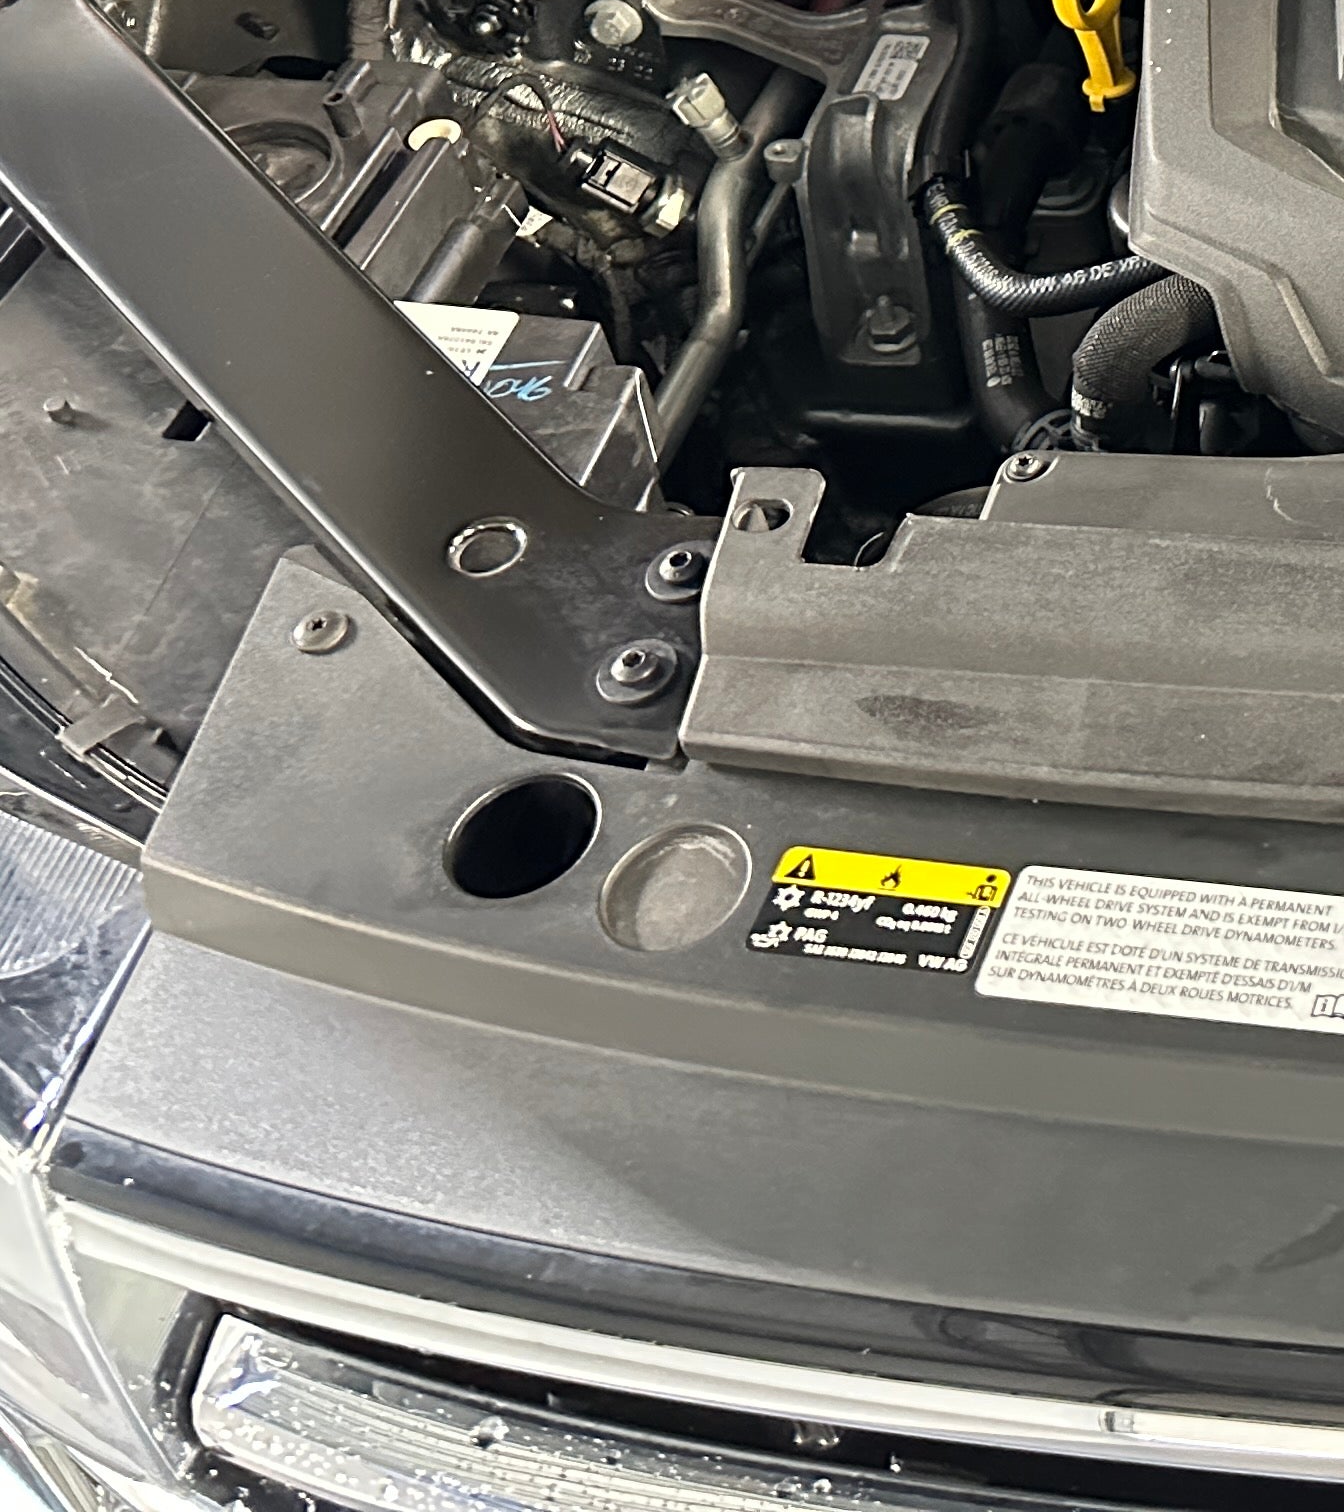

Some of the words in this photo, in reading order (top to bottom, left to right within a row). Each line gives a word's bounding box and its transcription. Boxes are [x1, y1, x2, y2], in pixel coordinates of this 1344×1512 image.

[810, 890, 875, 913] R-1234yf
[1018, 891, 1091, 909] ALL-WHEEL
[1094, 899, 1134, 914] DRIVE
[1137, 902, 1187, 918] SYSTEM
[1188, 908, 1220, 922] AND
[1222, 911, 1235, 924] IS
[1237, 913, 1290, 929] EXEMPT
[1292, 918, 1331, 933] FROM
[1026, 875, 1056, 888] THIS
[1058, 878, 1110, 894] VEHICLE
[1114, 884, 1127, 895] IS
[1129, 885, 1197, 903] EQUIPPED
[1199, 893, 1235, 907] WITH
[1237, 896, 1248, 907] A
[1250, 897, 1334, 917] PERMANENT
[793, 926, 829, 944] PAG
[1013, 906, 1067, 922] TESTING
[1070, 912, 1092, 925] ON
[1095, 914, 1128, 930] TWO
[1132, 919, 1178, 935] WHEEL
[1181, 923, 1225, 939] DRIVE
[1228, 928, 1337, 951] DYNAMOMETERS.
[918, 954, 947, 969] VW
[945, 958, 969, 973] AG
[1002, 932, 1018, 945] CE
[1086, 941, 1109, 955] EST
[1148, 947, 1183, 963] D'UN
[1243, 957, 1262, 971] DE
[988, 966, 1017, 979] SUR
[1140, 981, 1176, 997] DEUX
[1179, 986, 1225, 1003] ROUES
[1227, 991, 1293, 1009] MOTRICES.
[1065, 956, 1144, 975] PERMANENT
[1145, 963, 1161, 977] ET
[1221, 973, 1275, 989] D'ESSAIS
